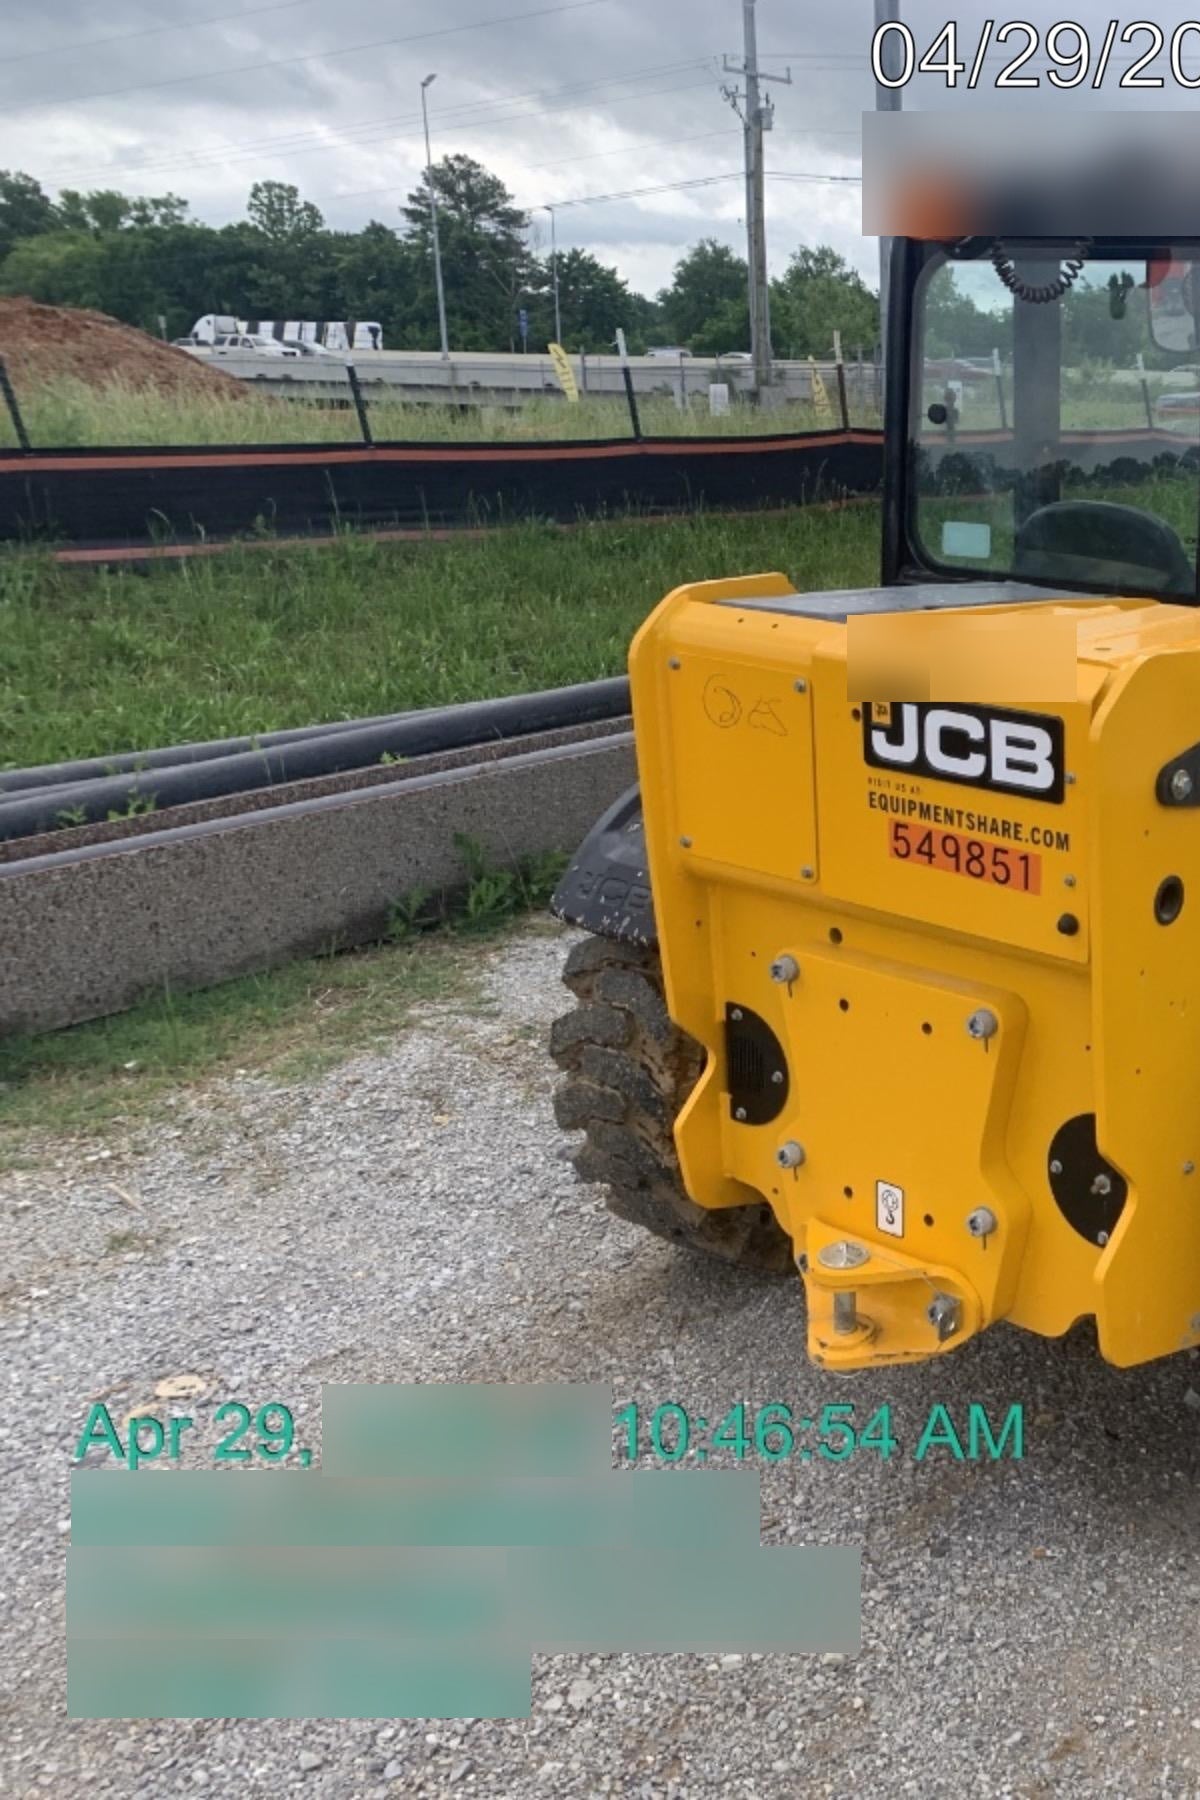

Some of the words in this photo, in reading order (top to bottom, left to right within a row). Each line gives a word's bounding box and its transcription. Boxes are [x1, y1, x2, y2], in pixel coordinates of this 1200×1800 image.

[871, 703, 1055, 789] JCB
[868, 791, 1070, 851] EQUIPMENTSHARE.COM
[892, 821, 1032, 891] 549851
